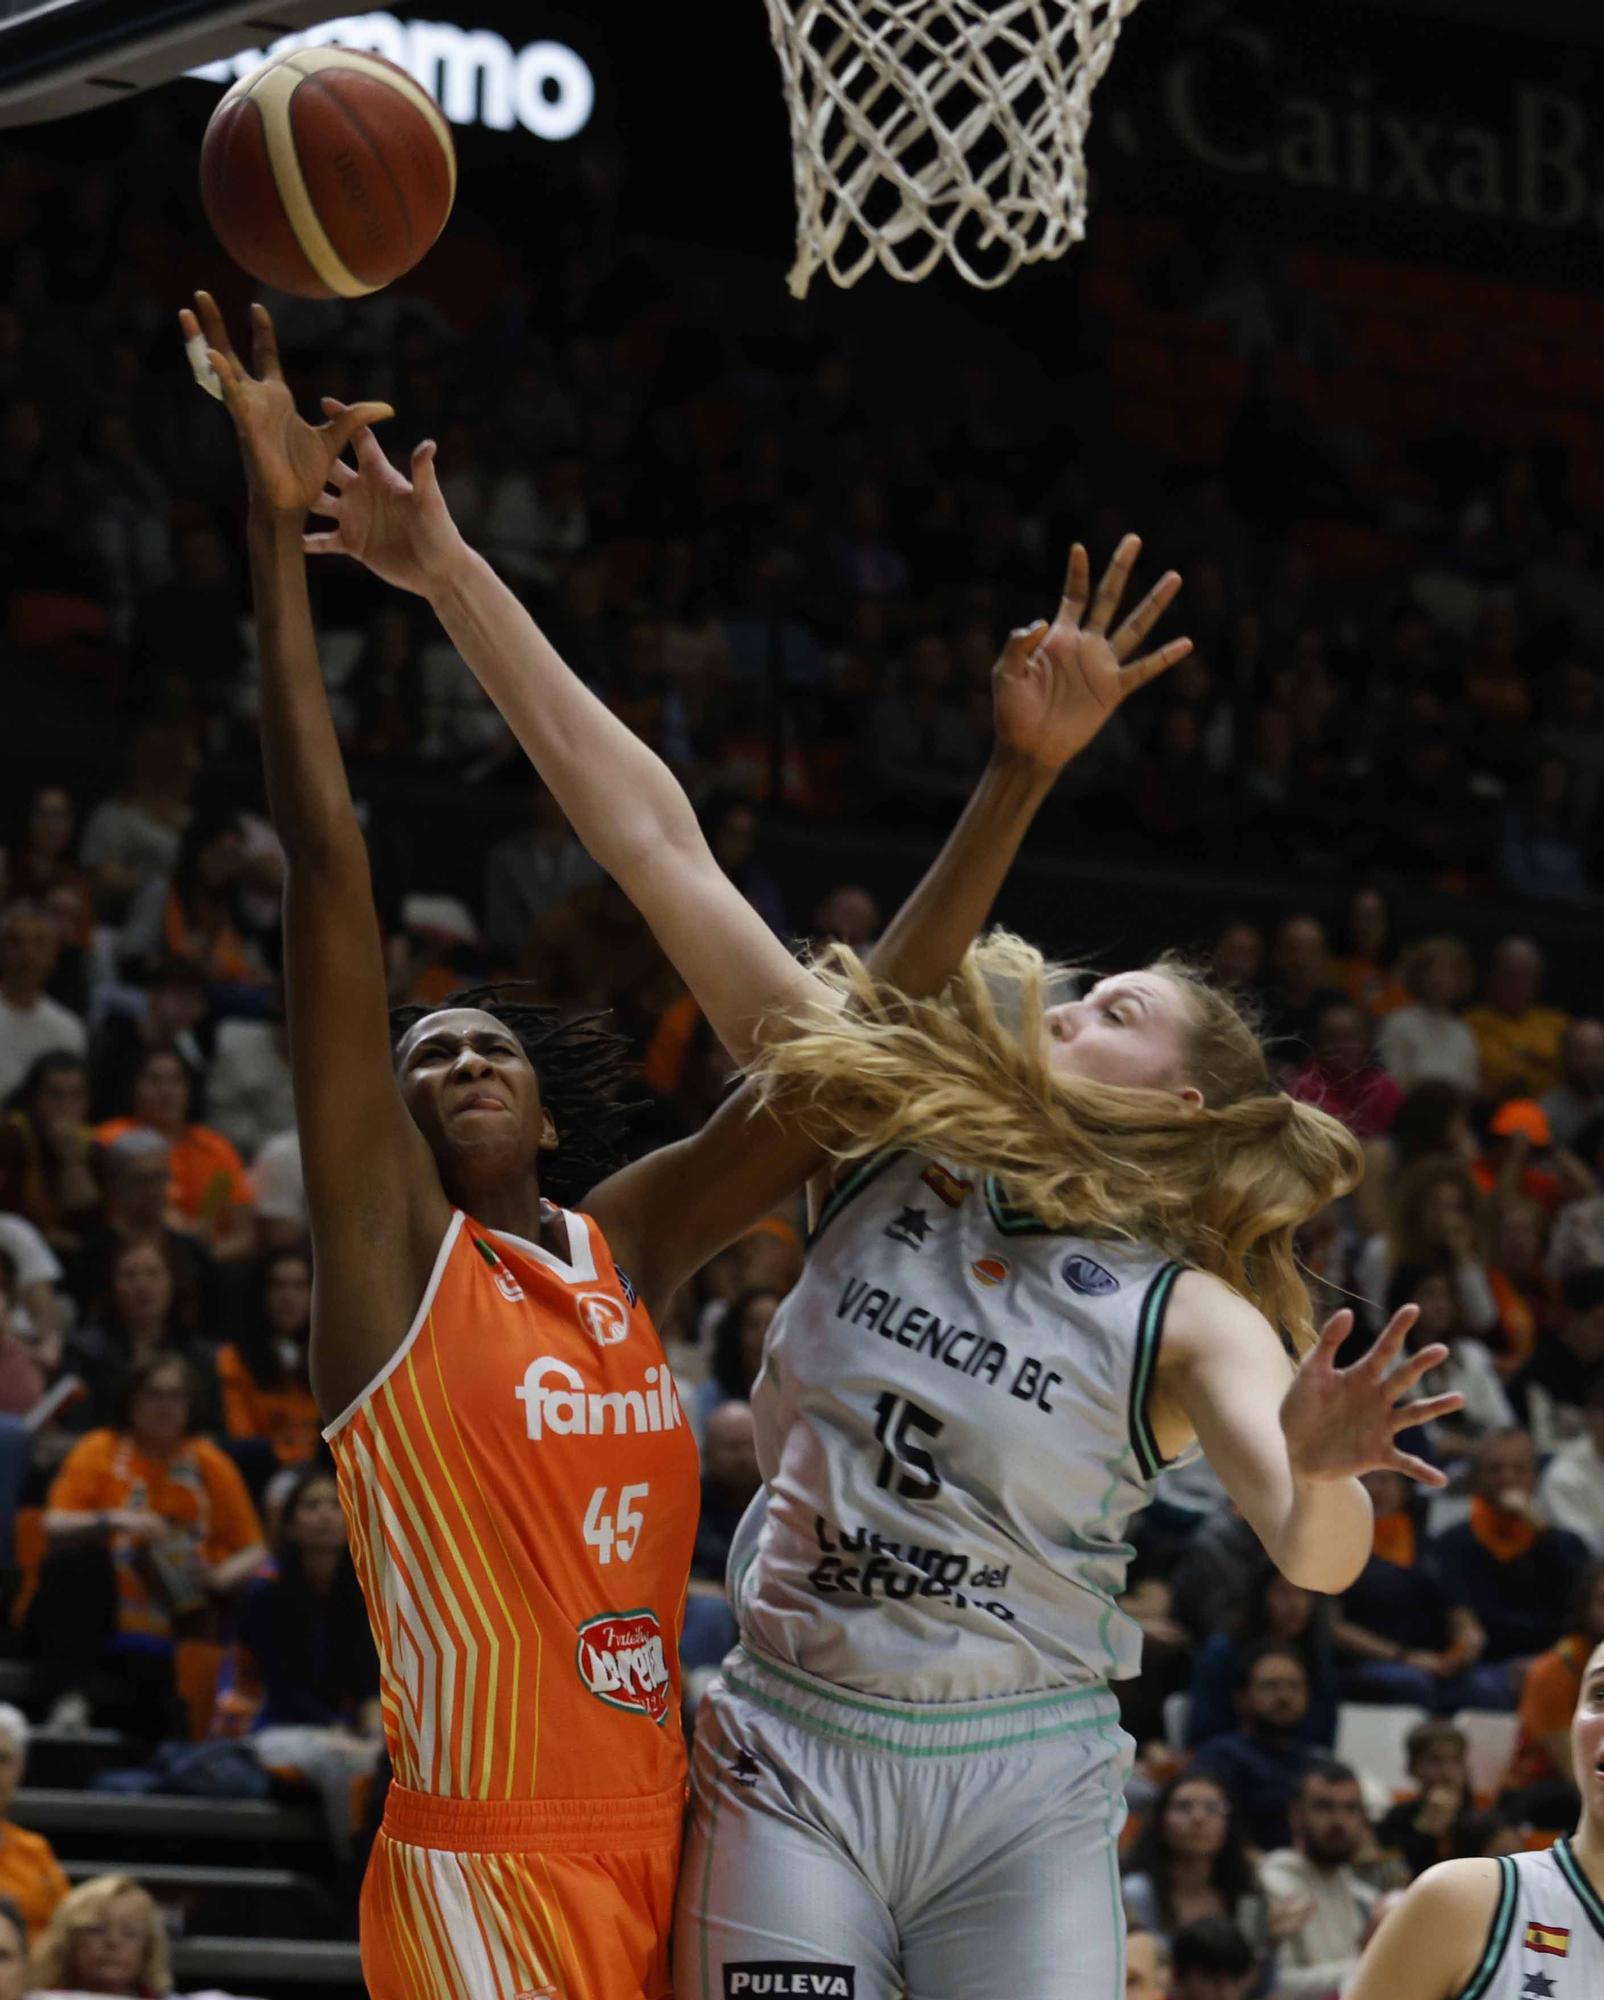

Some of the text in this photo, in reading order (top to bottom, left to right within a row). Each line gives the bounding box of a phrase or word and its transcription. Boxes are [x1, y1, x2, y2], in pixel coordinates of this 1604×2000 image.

[1162, 22, 1604, 228] CaixaB
[836, 1277, 1063, 1414] VALENCIA BC
[874, 1391, 944, 1499] 15
[583, 1482, 649, 1564] 45
[970, 1563, 1011, 1588] del
[730, 1972, 849, 1997] PULEVA
